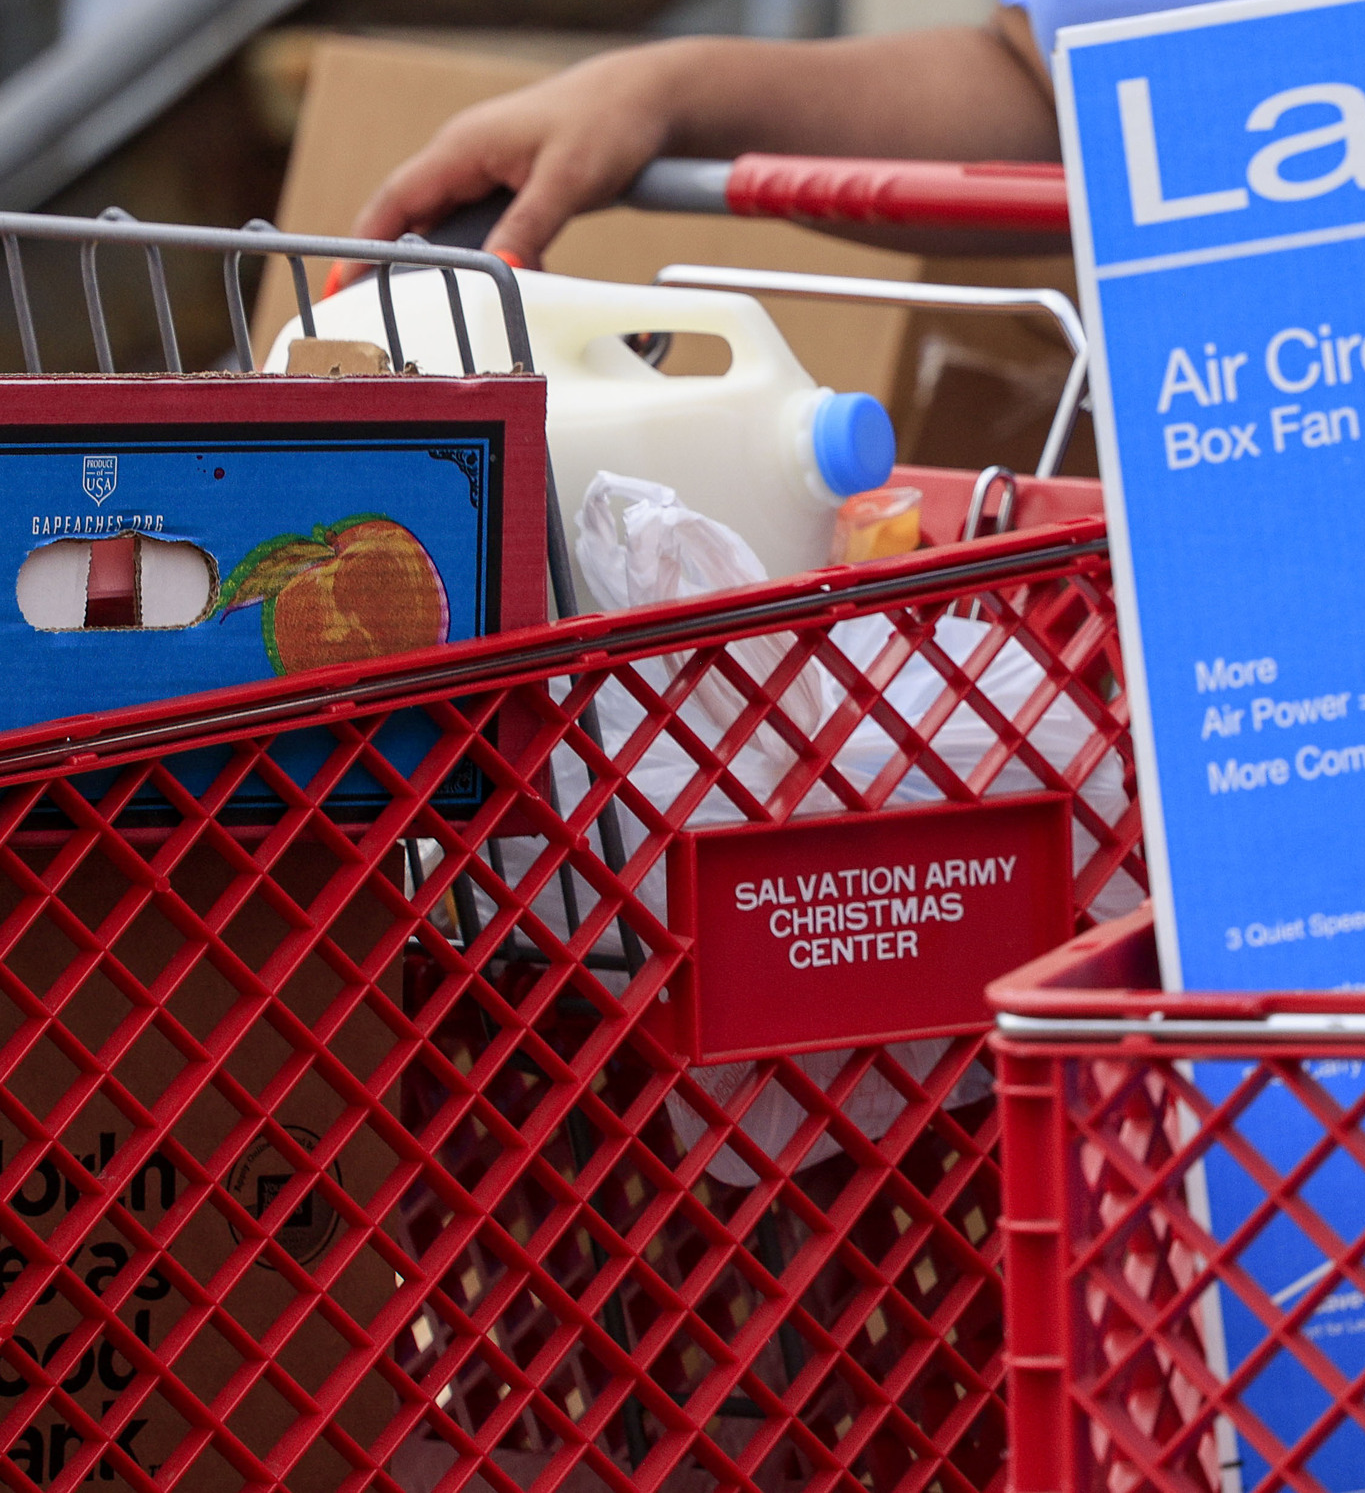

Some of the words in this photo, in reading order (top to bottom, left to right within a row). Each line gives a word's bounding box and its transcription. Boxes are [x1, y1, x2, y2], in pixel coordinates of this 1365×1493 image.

[1158, 342, 1247, 412] Air
[1164, 421, 1259, 470] Box
[1272, 403, 1359, 453] Fan
[87, 459, 113, 468] PRODUCE
[86, 477, 112, 498] USA
[32, 514, 164, 535] GAPEACHESORG
[1195, 657, 1277, 693] More
[1202, 704, 1245, 740] Air
[1251, 693, 1350, 732] Power
[1207, 758, 1289, 794] More
[735, 864, 915, 911] SALVATION
[925, 856, 1016, 890] ARMY
[769, 893, 964, 938] CHRISTMAS
[1225, 927, 1243, 951] 3
[1245, 919, 1305, 947] Quiet
[789, 930, 918, 969] CENTER
[0, 1132, 176, 1216] orth
[0, 1241, 172, 1305] eas
[0, 1309, 151, 1397] ood
[5, 1399, 149, 1485] ank
